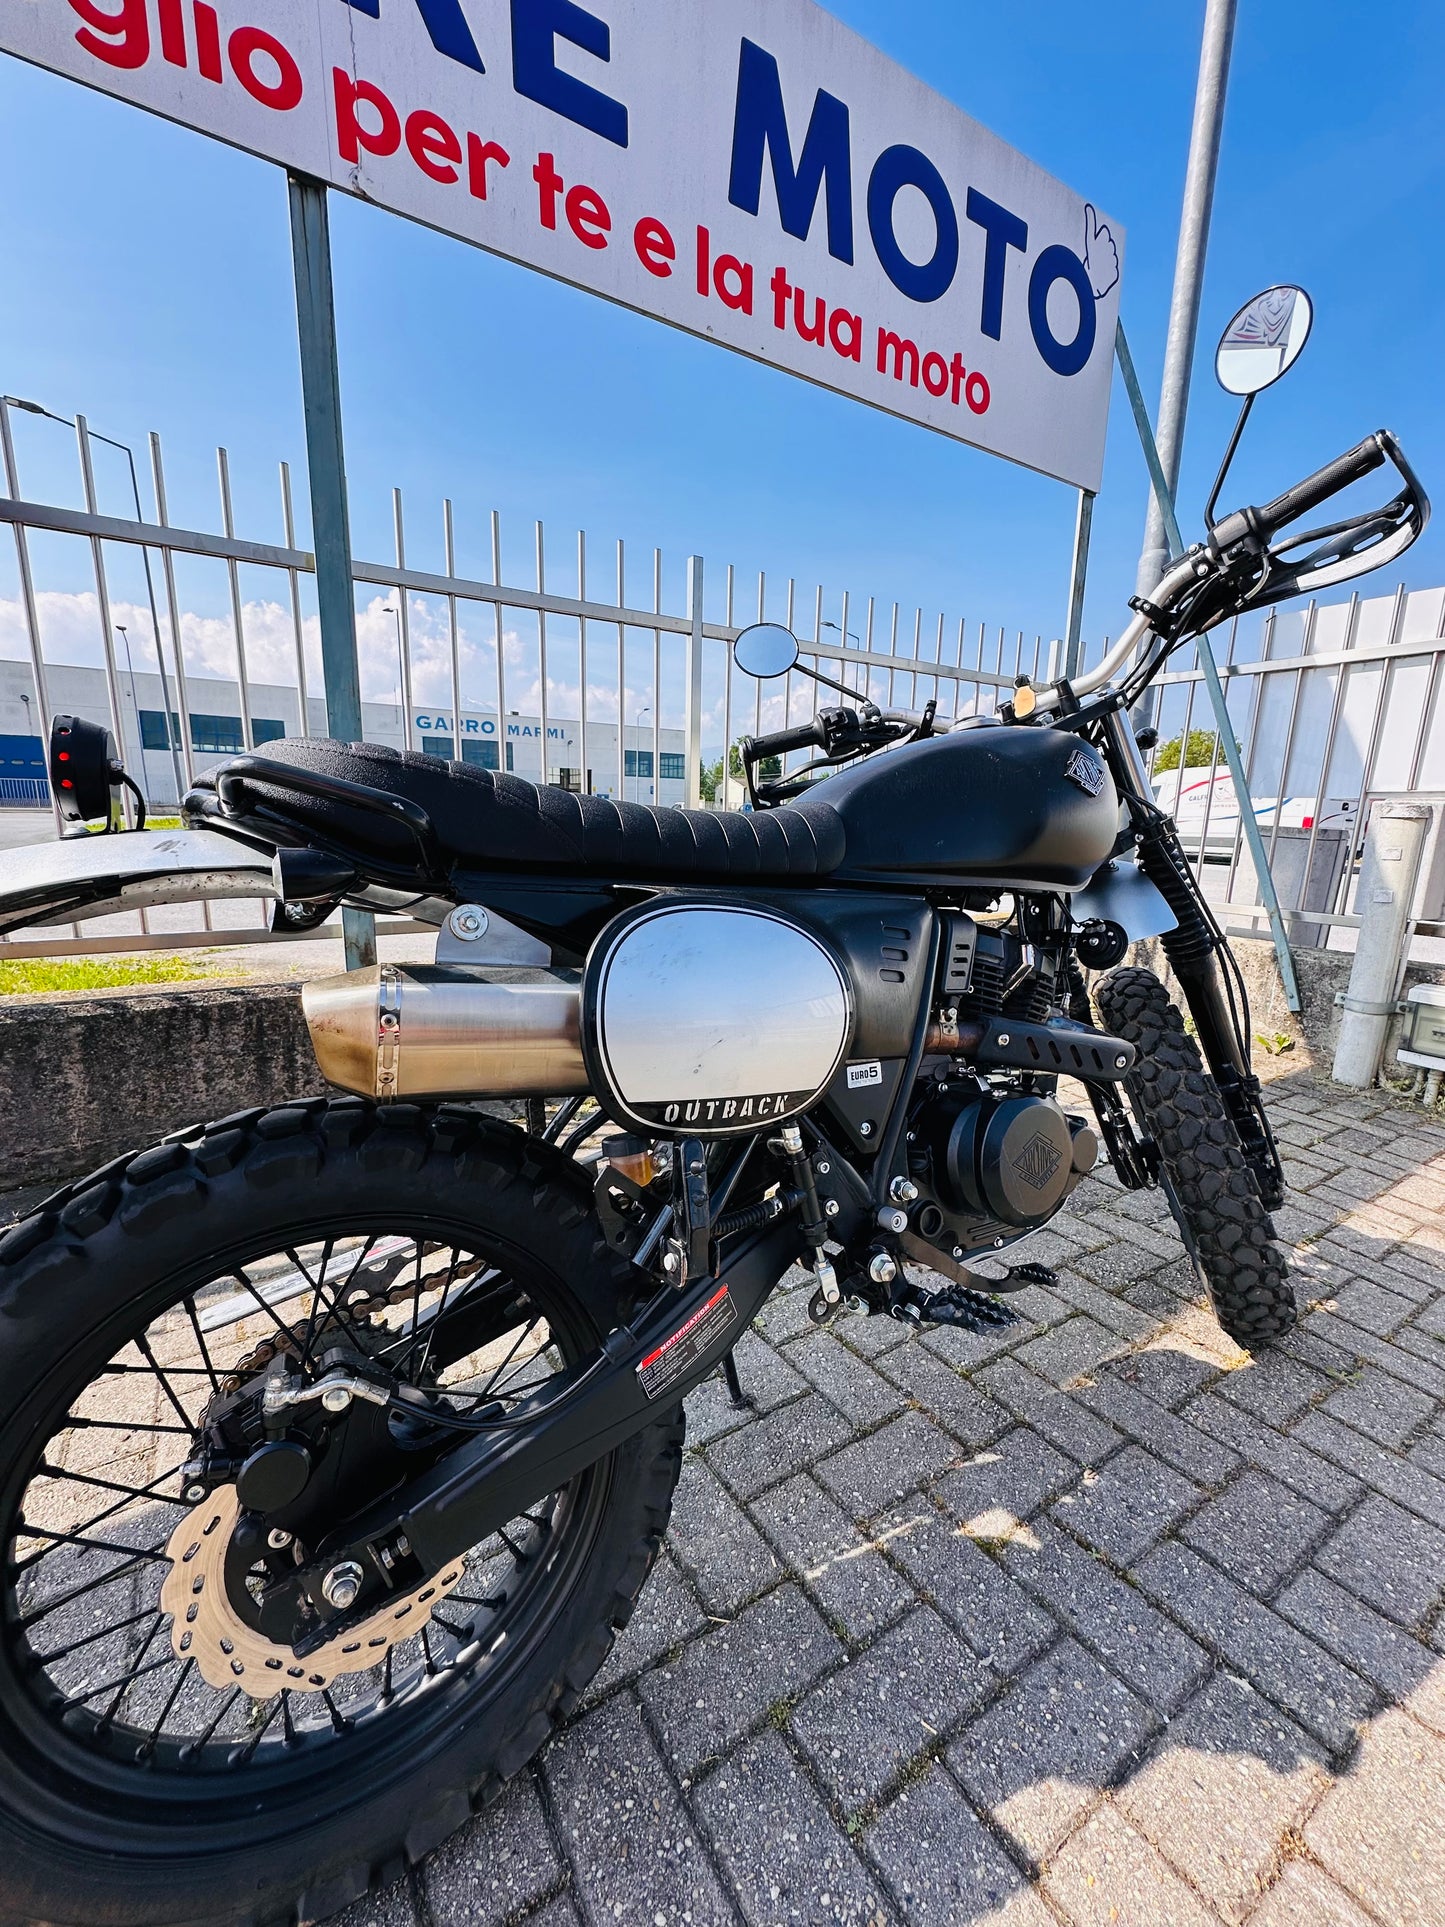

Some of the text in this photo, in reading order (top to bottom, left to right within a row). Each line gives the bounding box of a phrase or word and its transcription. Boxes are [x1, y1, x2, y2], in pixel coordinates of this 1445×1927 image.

[333, 68, 509, 200] per
[533, 153, 611, 249] te
[634, 217, 675, 277] e
[697, 226, 752, 315] la
[771, 268, 862, 362] tua
[877, 328, 990, 414] moto
[729, 37, 1105, 376] MOTO
[664, 1095, 789, 1123] OUTBACK
[660, 1303, 711, 1353] NOTIFICATION
